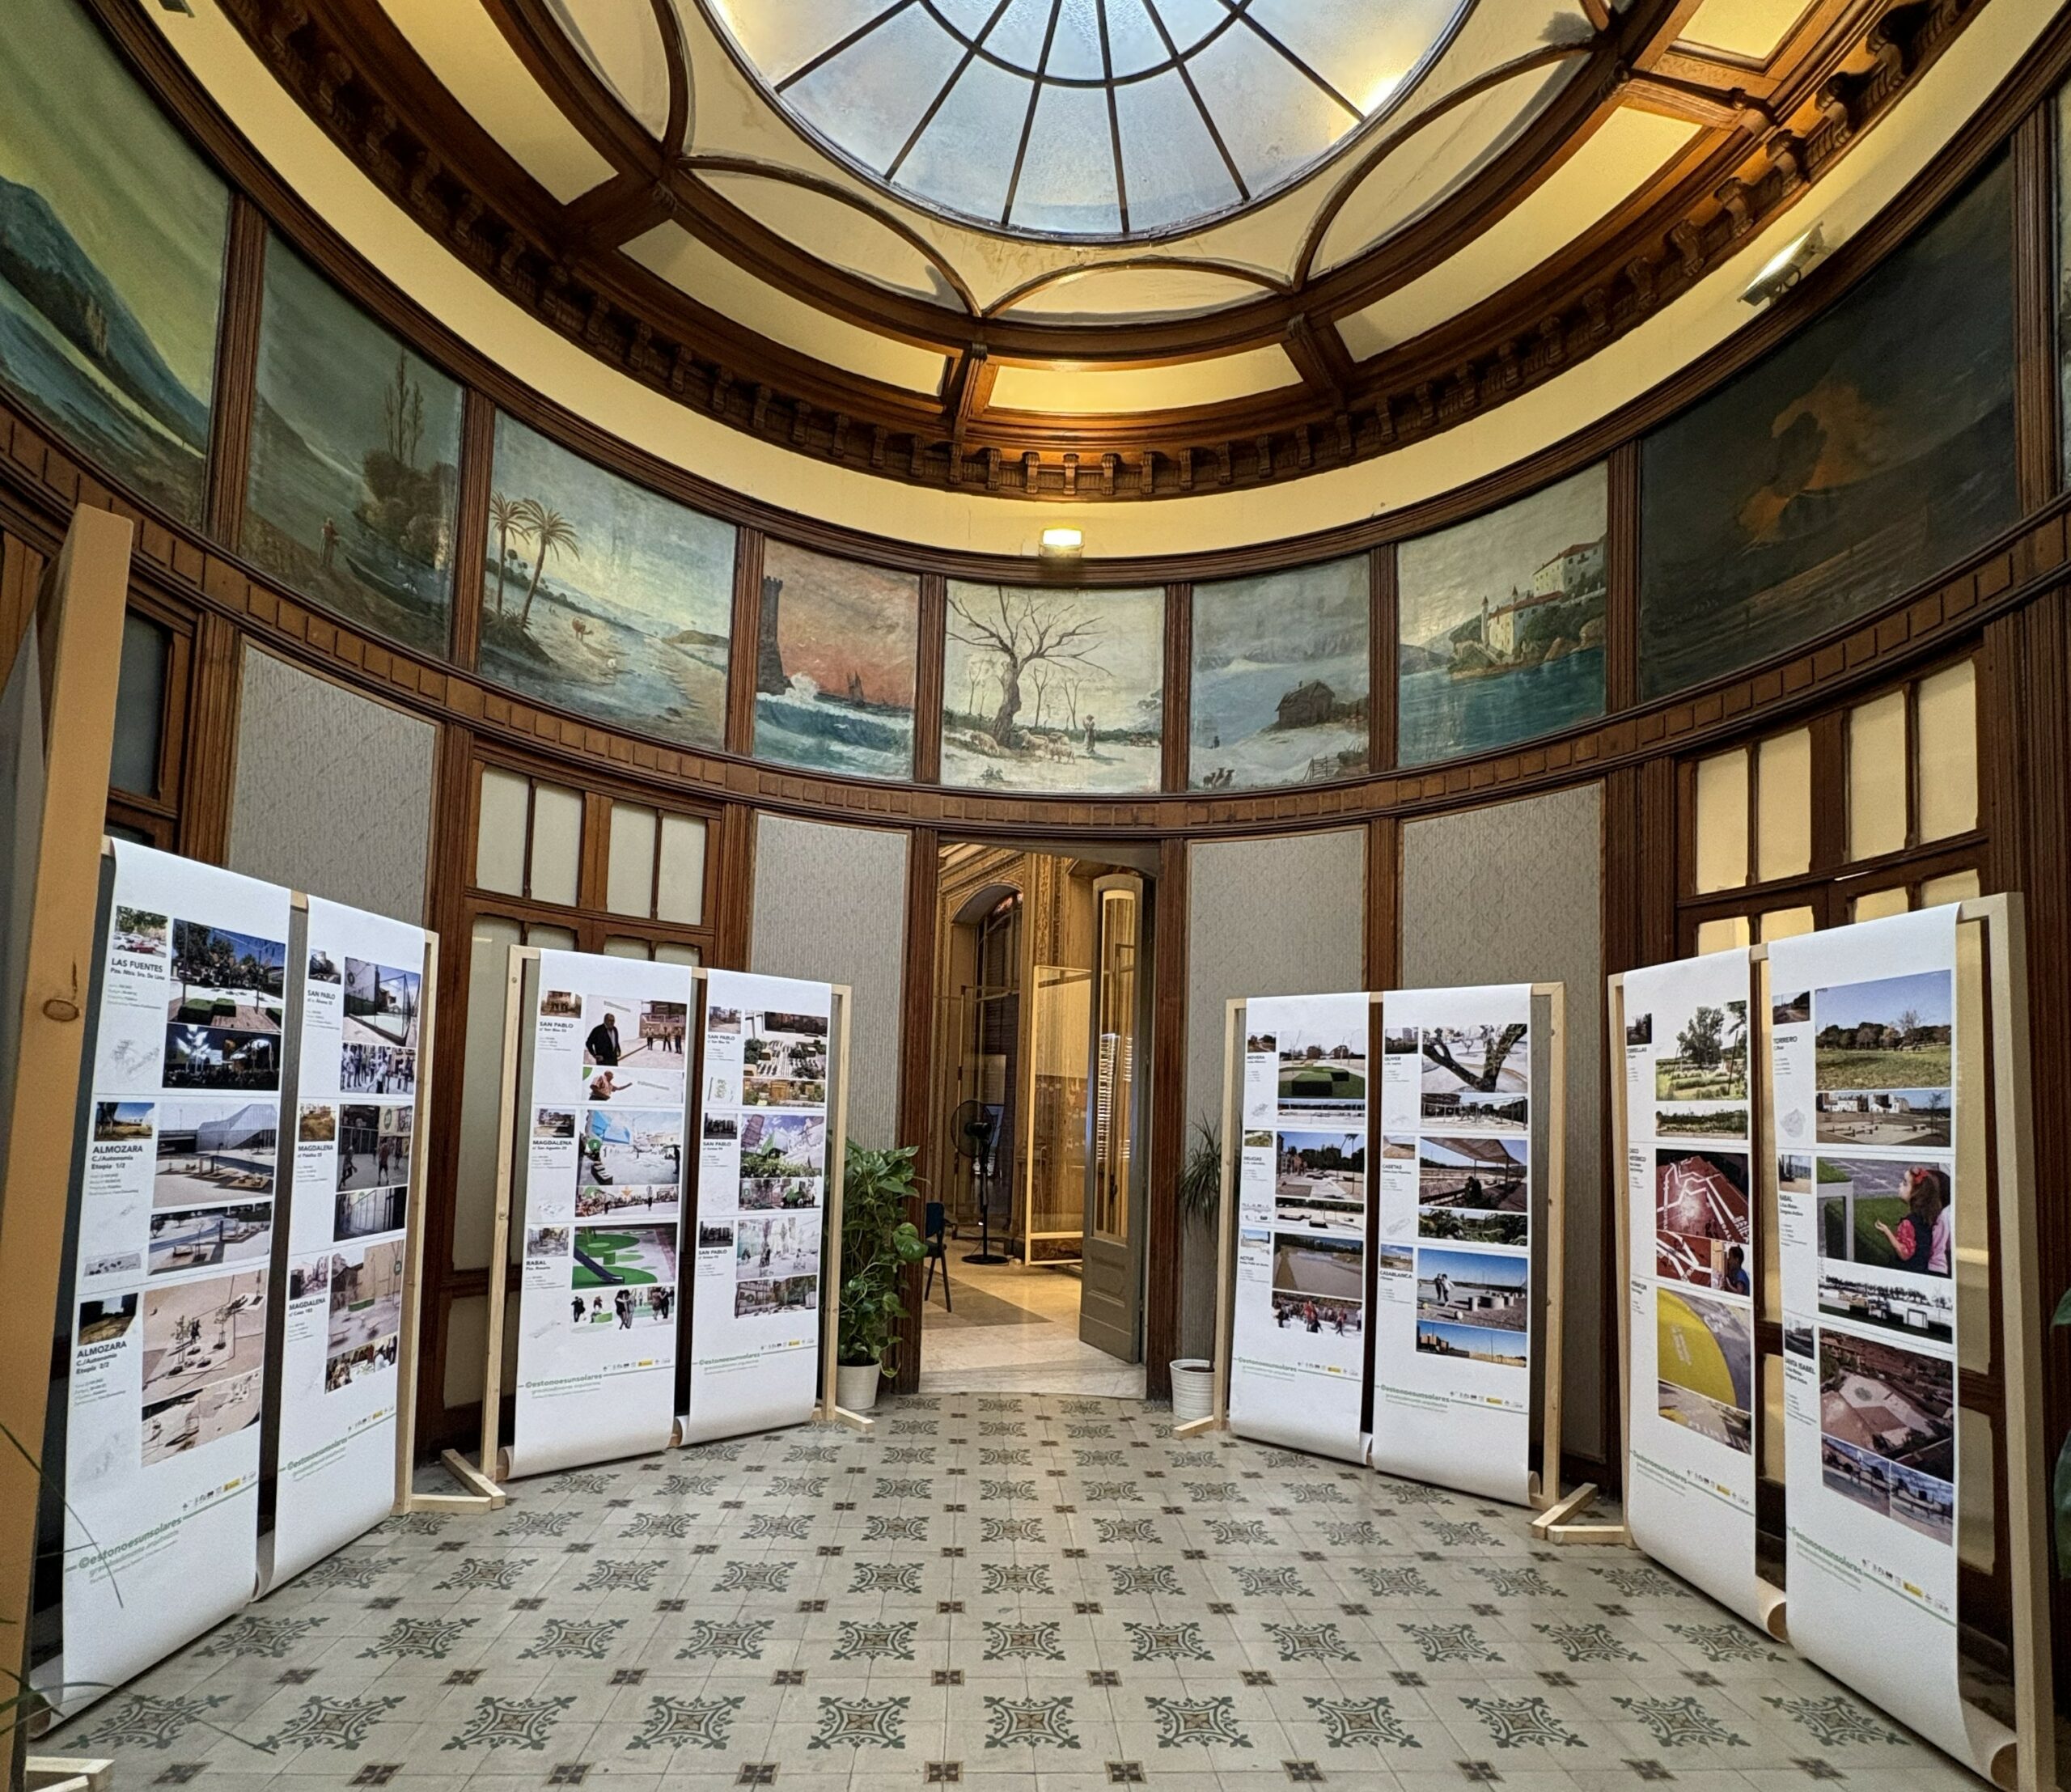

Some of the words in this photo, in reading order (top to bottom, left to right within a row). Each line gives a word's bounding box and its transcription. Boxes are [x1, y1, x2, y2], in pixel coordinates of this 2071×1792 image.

[111, 958, 128, 968] LAS
[129, 960, 163, 973] FUENTES
[1773, 1036, 1798, 1044] TORRERO
[92, 1145, 143, 1154] ALMOZARA
[289, 1298, 326, 1311] MAGDALENA
[77, 1341, 127, 1358] ALMOZARA
